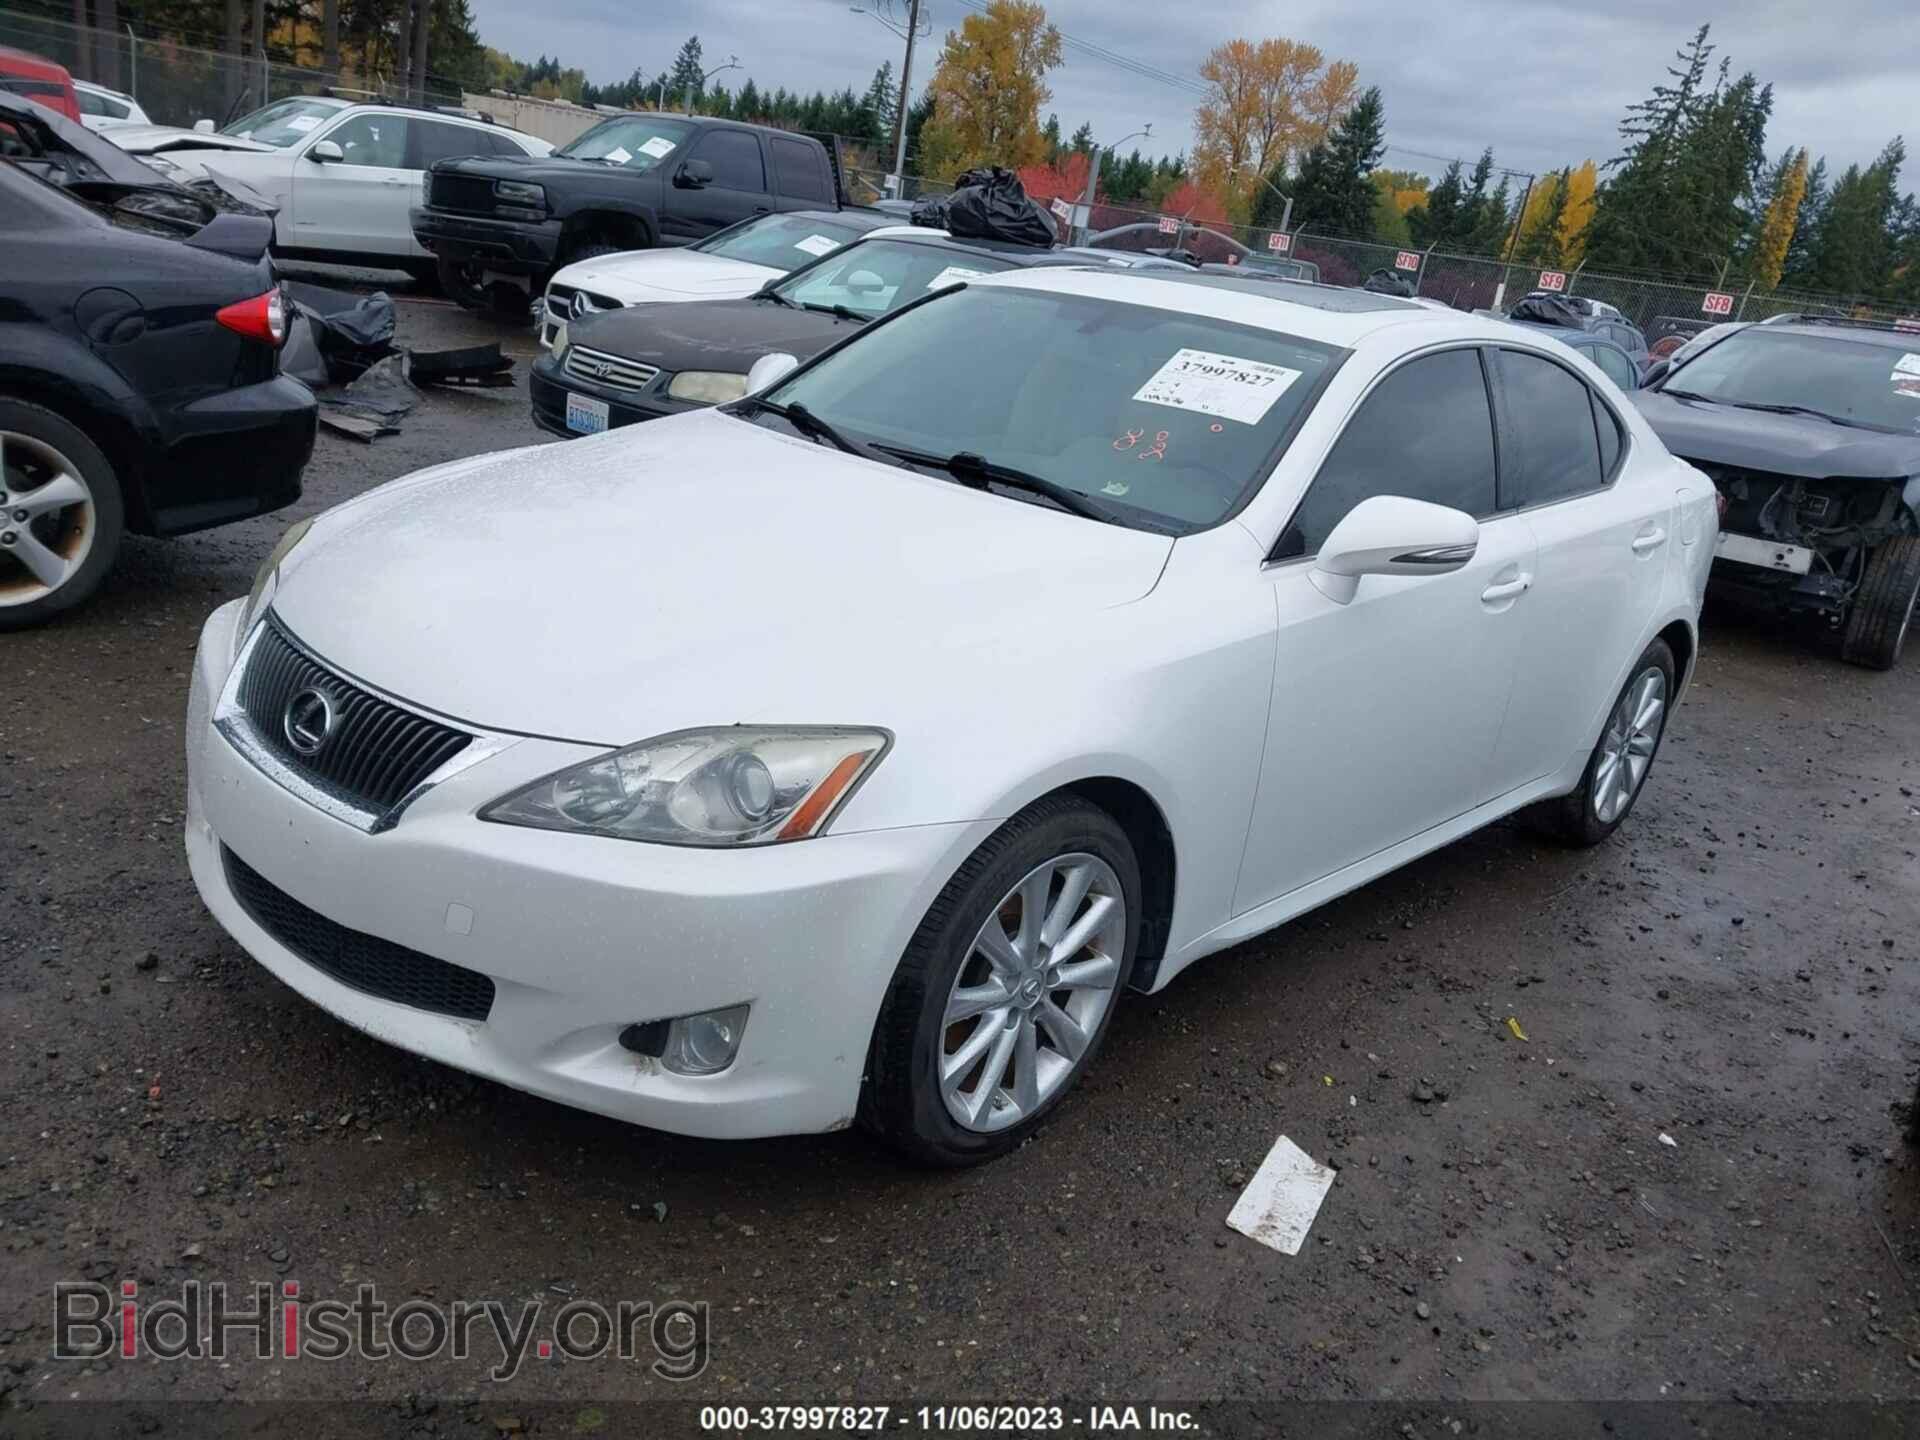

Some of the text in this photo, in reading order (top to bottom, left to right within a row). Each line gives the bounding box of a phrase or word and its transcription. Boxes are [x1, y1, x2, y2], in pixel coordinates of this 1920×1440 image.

[1271, 235, 1288, 249] SF11
[1397, 253, 1418, 268] SF10
[1541, 273, 1563, 288] SF9
[1705, 295, 1730, 311] SF8
[1175, 361, 1275, 387] 37997827
